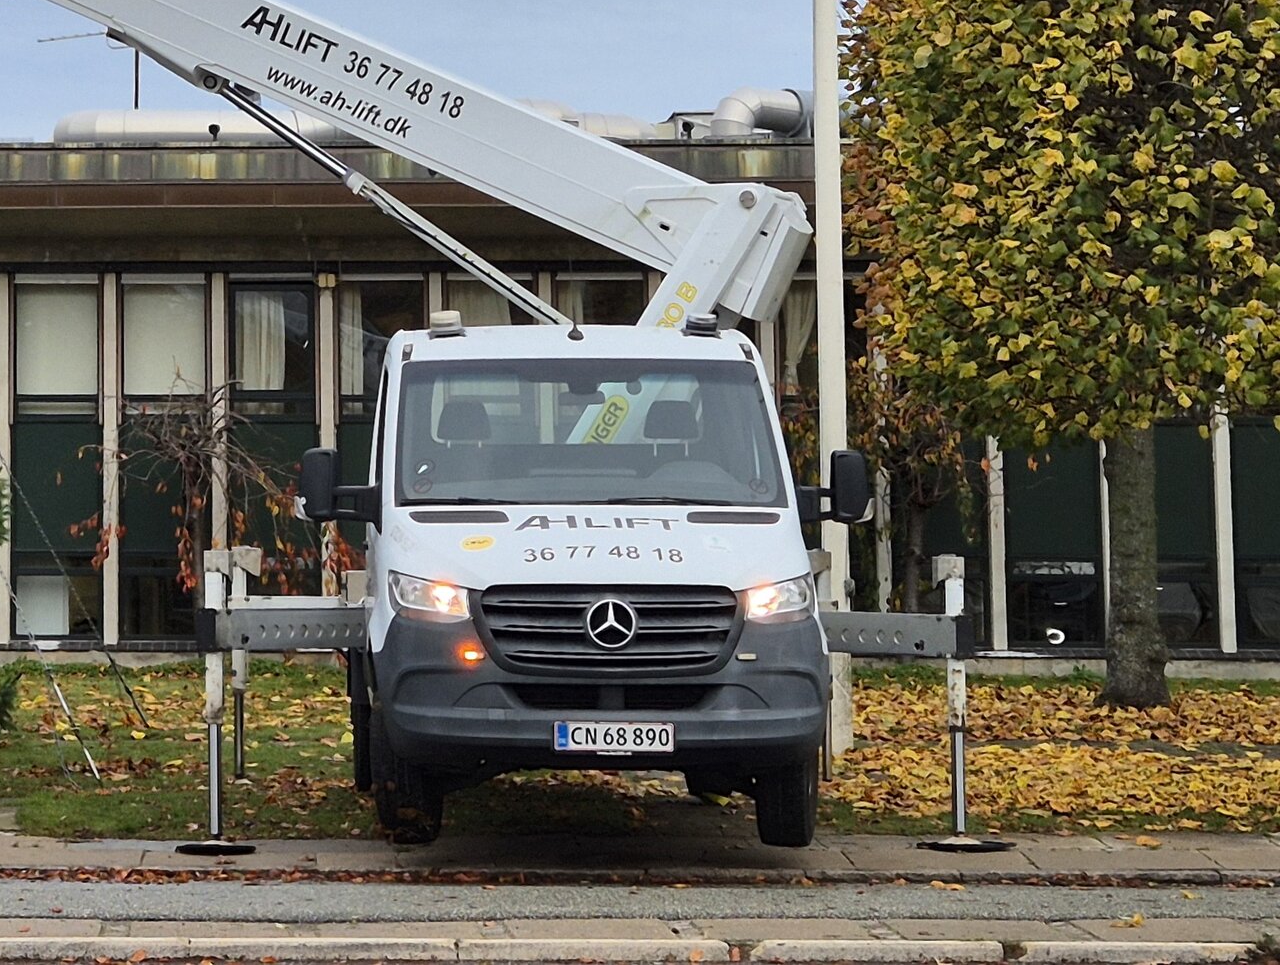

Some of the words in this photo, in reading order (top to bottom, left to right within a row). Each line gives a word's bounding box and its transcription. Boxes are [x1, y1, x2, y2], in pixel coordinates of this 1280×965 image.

[266, 65, 412, 139] www.ah-lift.dk
[343, 50, 372, 79] 36
[375, 63, 404, 91] 77
[405, 78, 433, 105] 48
[439, 90, 465, 119] 18
[523, 547, 555, 563] 36
[566, 545, 596, 559] 77
[608, 545, 640, 560] 48
[652, 547, 684, 563] 18
[570, 726, 598, 746] CN
[603, 727, 628, 747] 68
[632, 727, 671, 747] 890
